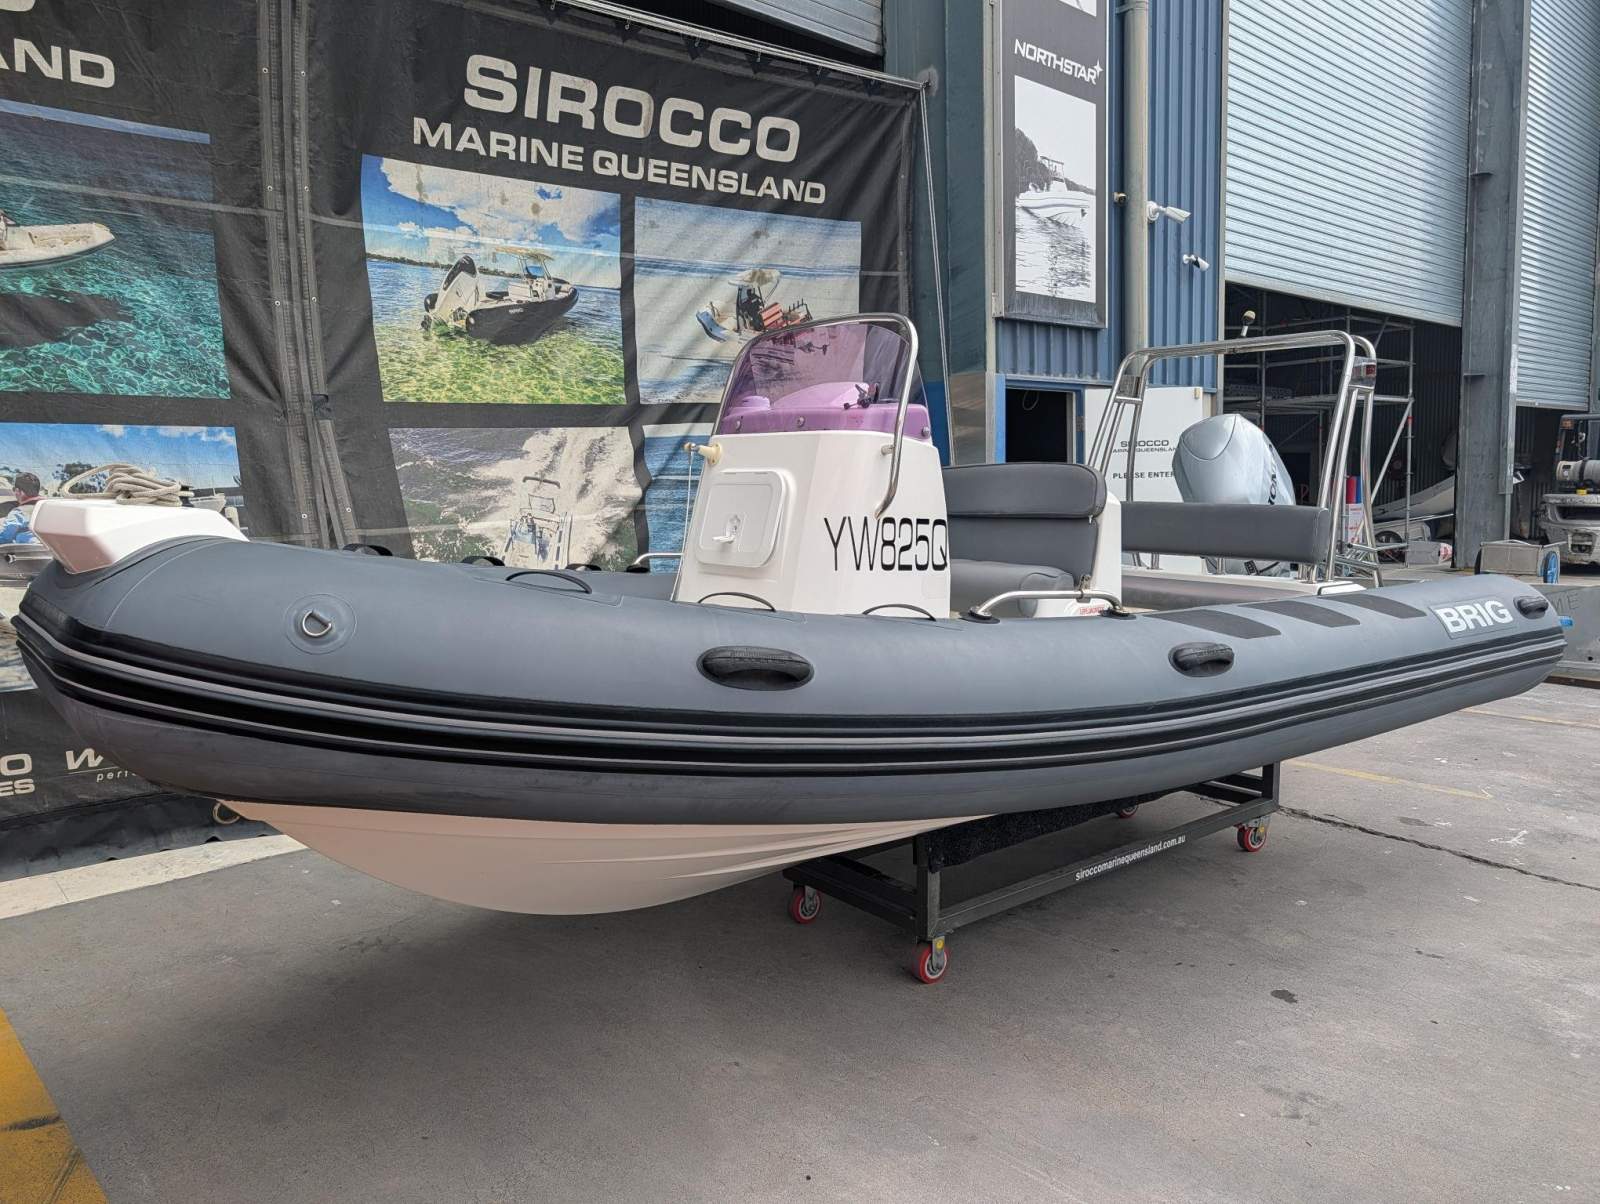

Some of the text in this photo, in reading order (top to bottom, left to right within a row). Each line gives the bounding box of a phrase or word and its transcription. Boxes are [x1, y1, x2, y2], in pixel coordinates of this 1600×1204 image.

[0, 38, 115, 88] ND
[1014, 38, 1097, 86] NORTHSTAR
[463, 54, 801, 163] SIROCCO
[412, 117, 827, 205] MARINE QUEENSLAND
[1120, 440, 1170, 448] SOCCO
[823, 516, 948, 571] YW825Q
[1434, 599, 1514, 633] BRIG
[1075, 834, 1186, 881] siroccomarinequeensland.com.au
